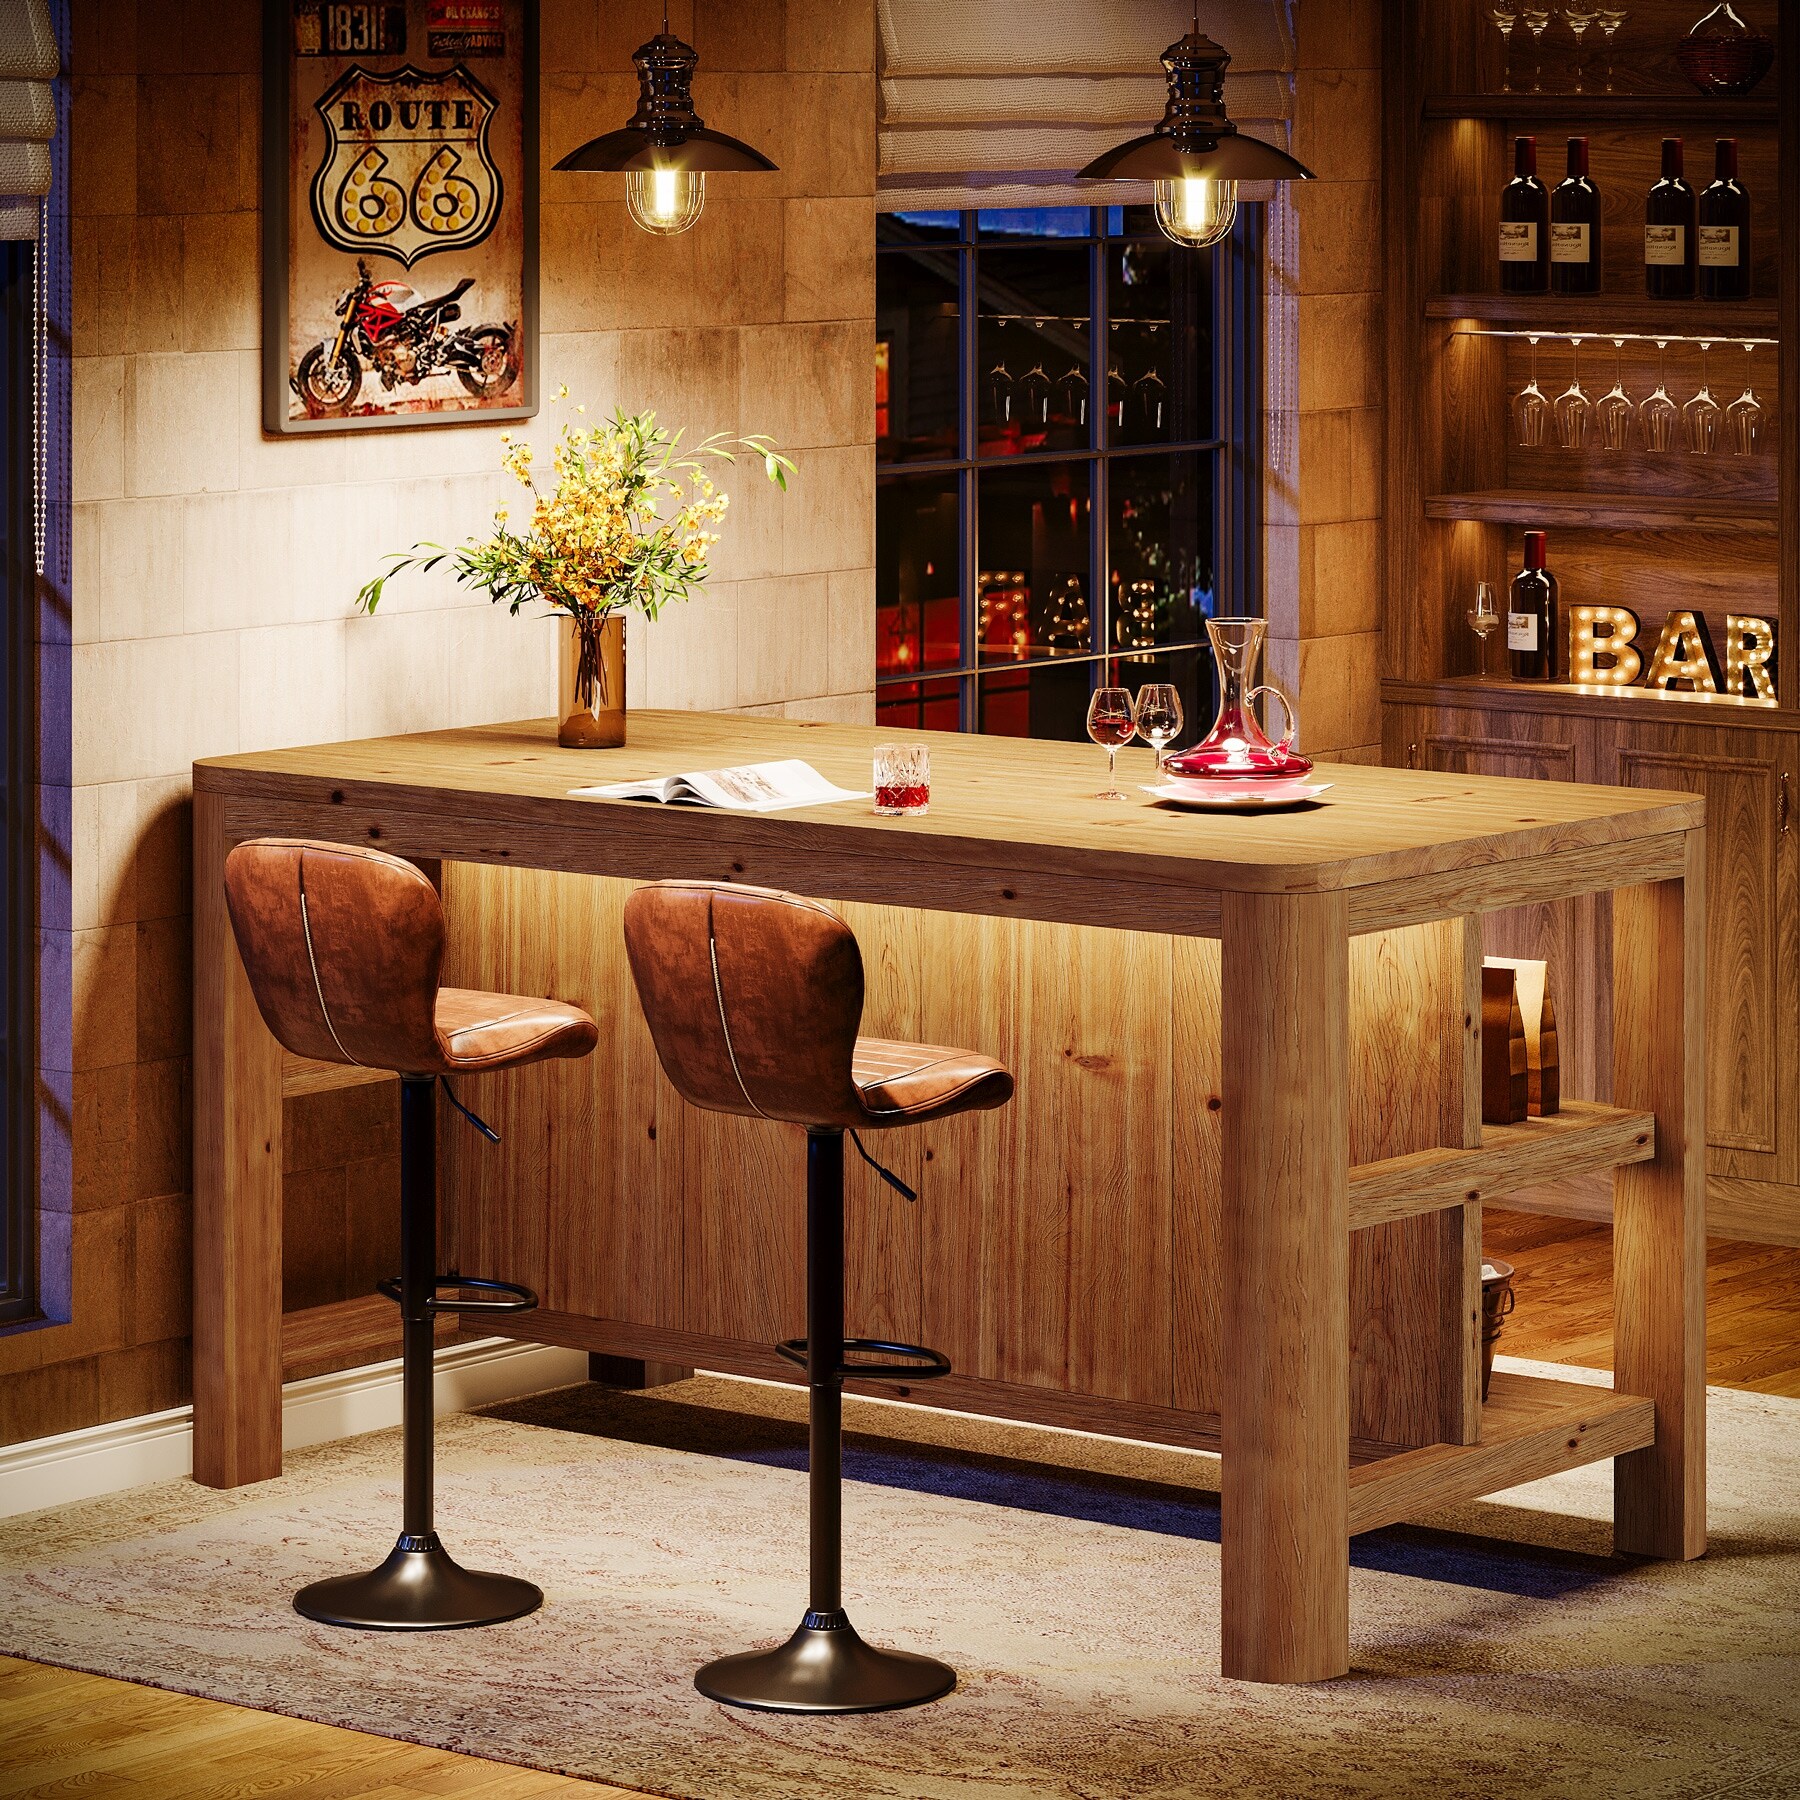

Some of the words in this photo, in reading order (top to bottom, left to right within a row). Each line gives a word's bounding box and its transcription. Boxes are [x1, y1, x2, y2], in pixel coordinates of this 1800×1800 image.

[339, 100, 474, 131] ROUTE
[335, 144, 480, 237] 66
[1569, 604, 1778, 699] BAR
